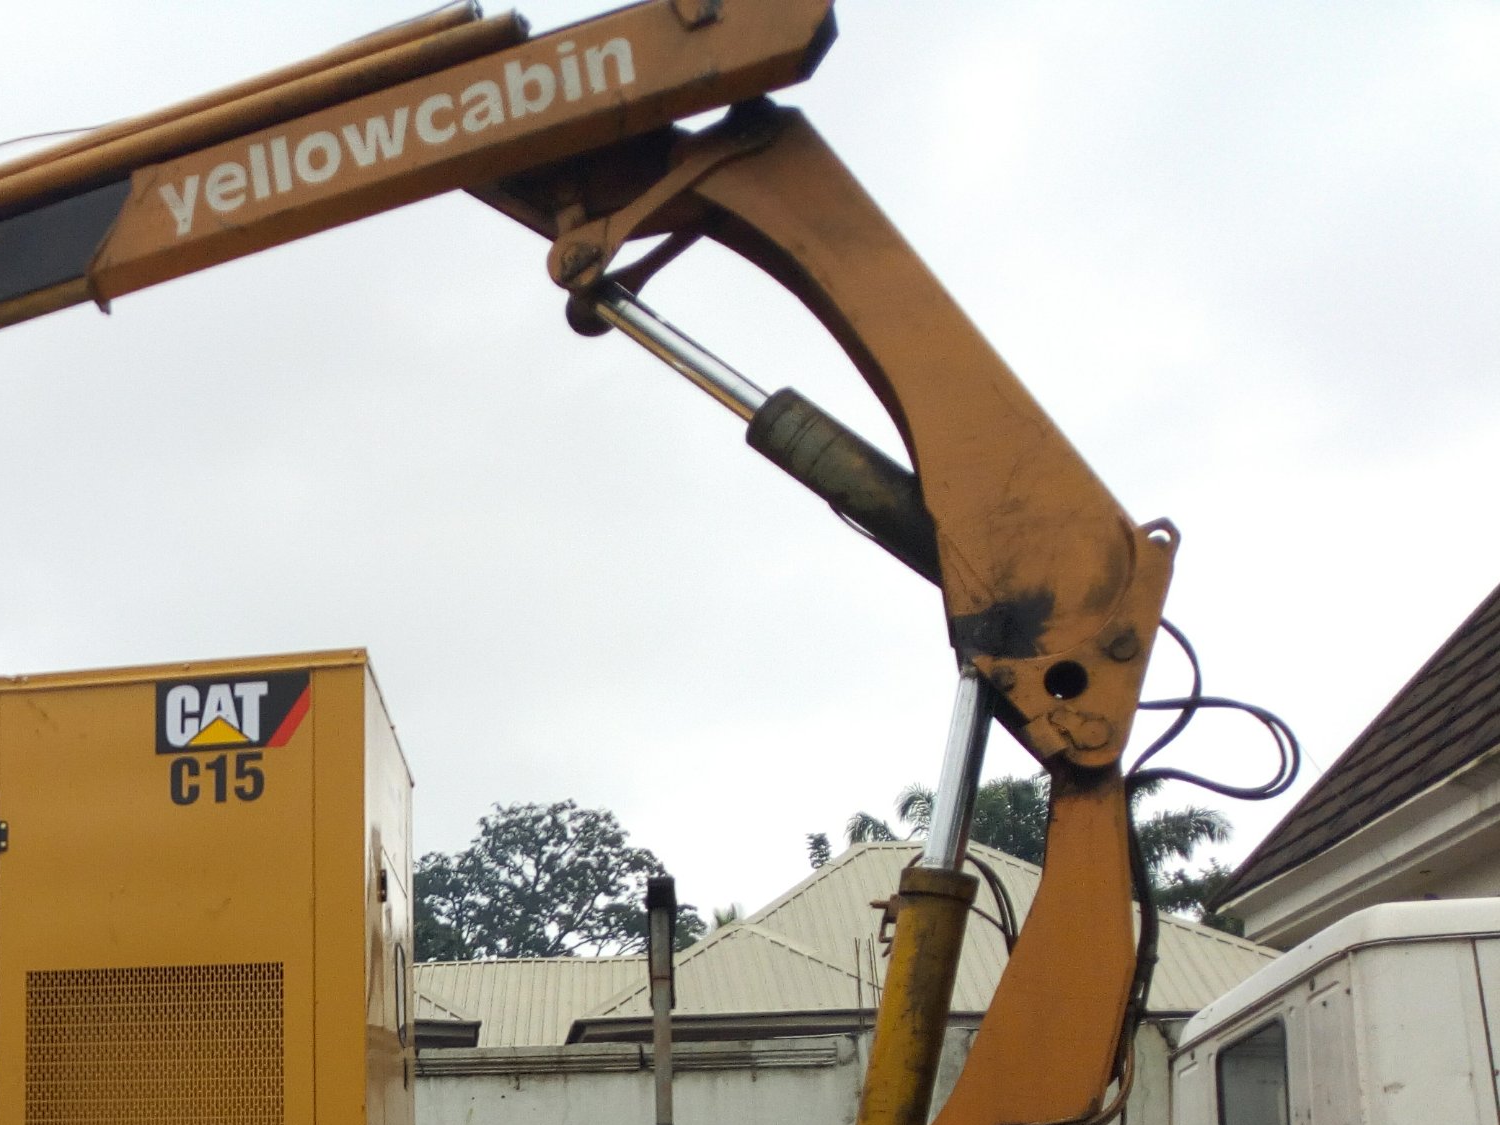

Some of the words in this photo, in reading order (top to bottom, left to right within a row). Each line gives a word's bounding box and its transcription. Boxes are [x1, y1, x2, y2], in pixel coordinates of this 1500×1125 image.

[158, 36, 637, 237] yellowcabin
[165, 681, 269, 748] CAT
[170, 753, 265, 806] C15
